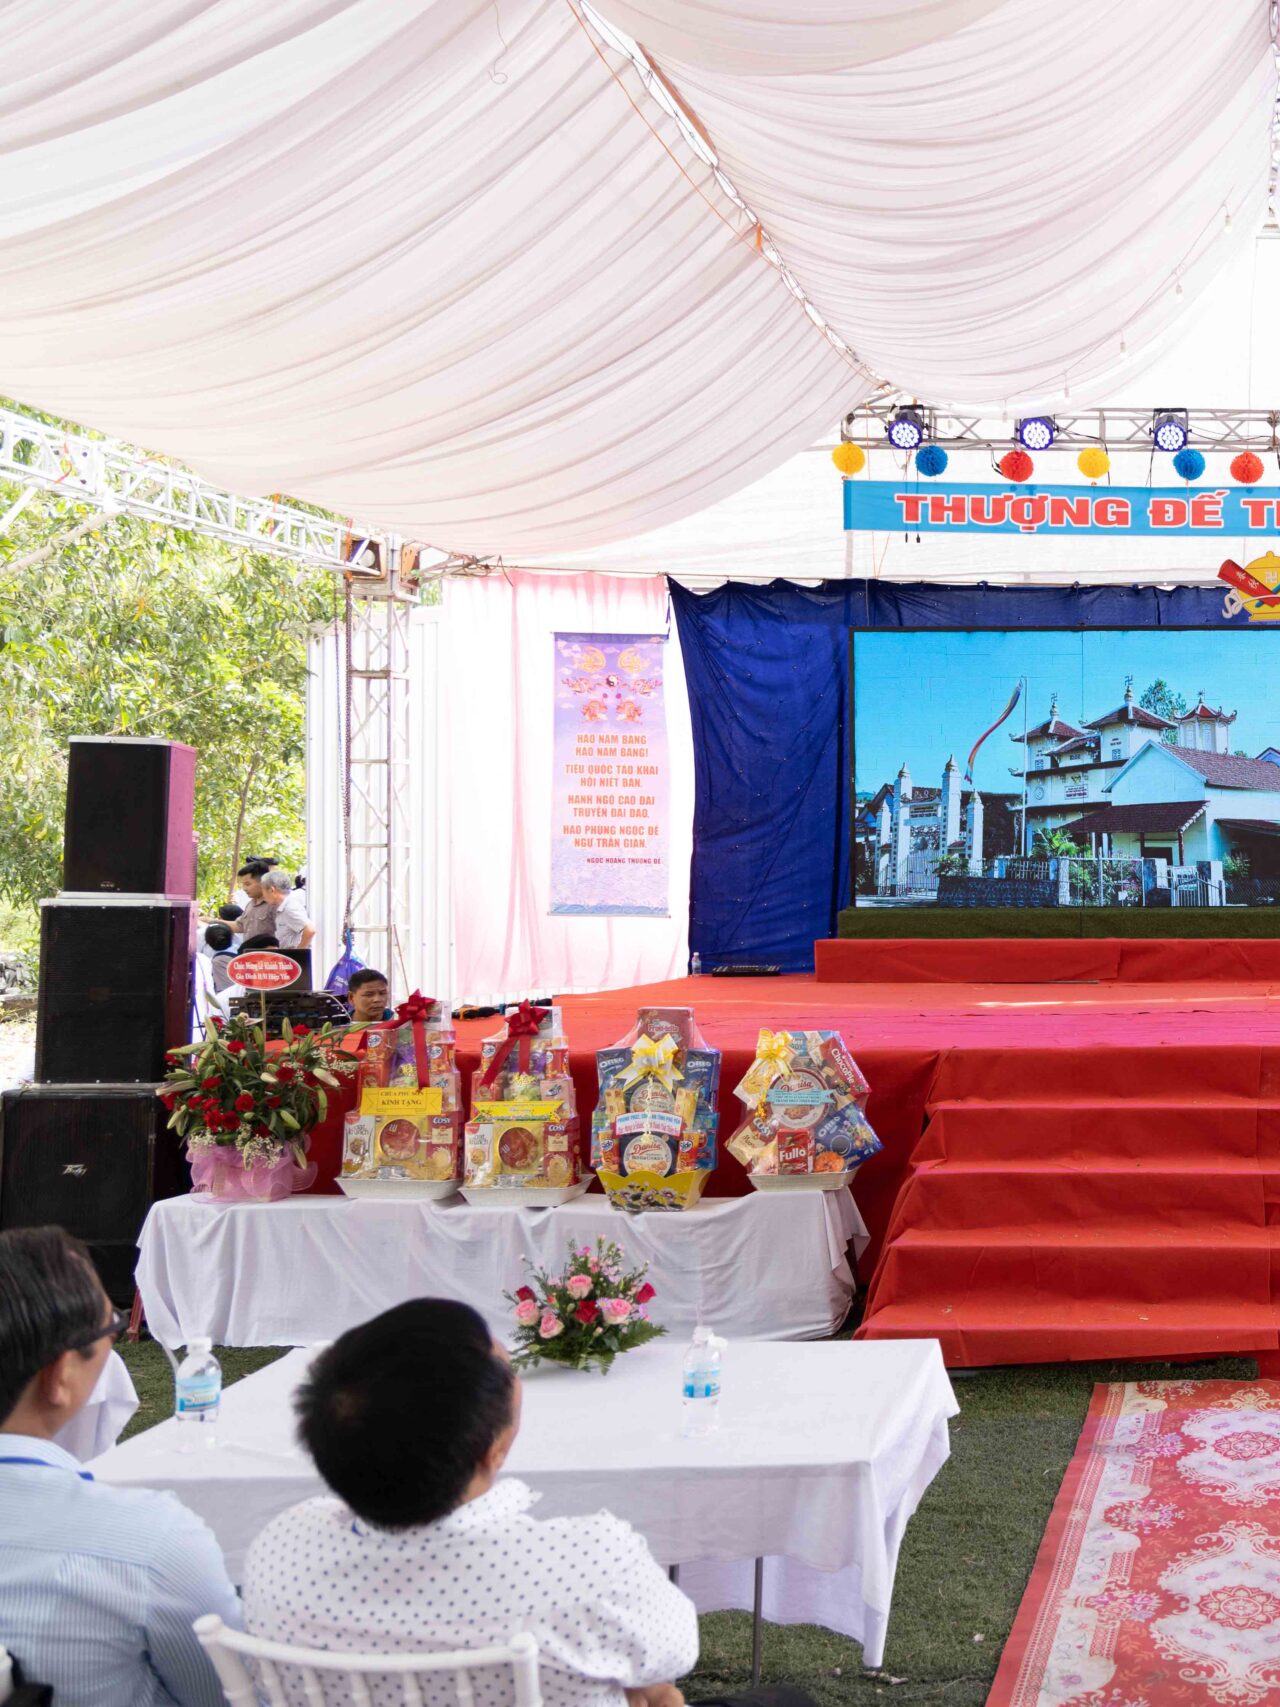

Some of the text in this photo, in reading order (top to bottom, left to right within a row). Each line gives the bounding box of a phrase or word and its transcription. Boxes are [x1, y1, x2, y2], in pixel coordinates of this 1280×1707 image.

[895, 493, 1131, 532] THƯỢNG
[1149, 490, 1230, 529] ĐẾ
[598, 735, 619, 744] NAM
[622, 735, 647, 745] BANG
[597, 747, 617, 757] NAM
[637, 765, 658, 775] KHAI
[600, 1057, 624, 1068] OREO
[687, 1060, 712, 1068] OREO
[640, 1089, 668, 1100] Dnisa
[818, 1116, 841, 1138] OREO
[629, 1143, 661, 1155] Danisa
[779, 1147, 806, 1161] Fullo
